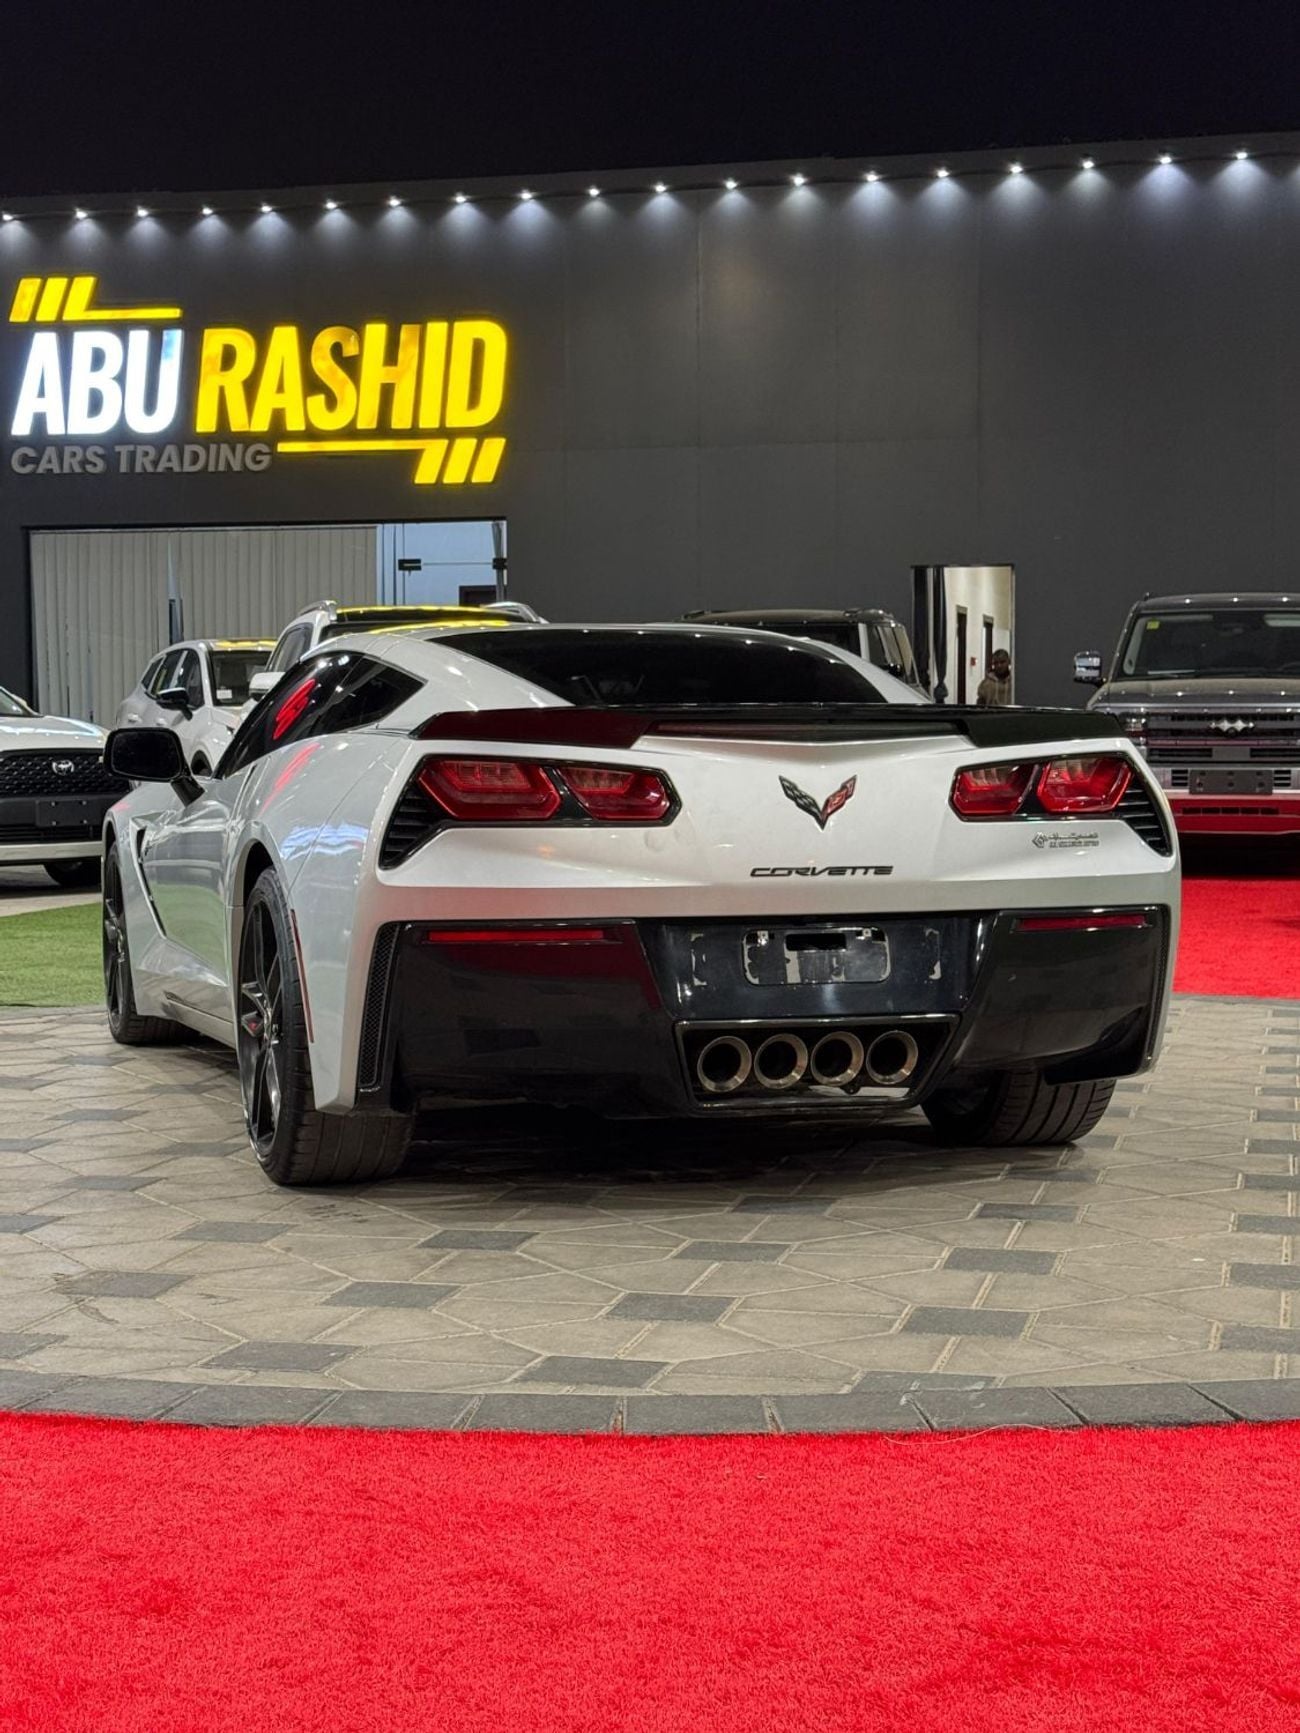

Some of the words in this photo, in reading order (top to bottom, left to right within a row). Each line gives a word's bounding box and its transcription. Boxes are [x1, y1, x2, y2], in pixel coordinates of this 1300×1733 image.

[10, 328, 184, 437] ABU
[195, 320, 508, 433] RASHID
[10, 445, 107, 475] CARS
[114, 443, 273, 473] TRADING
[750, 865, 894, 877] CORVETTE
